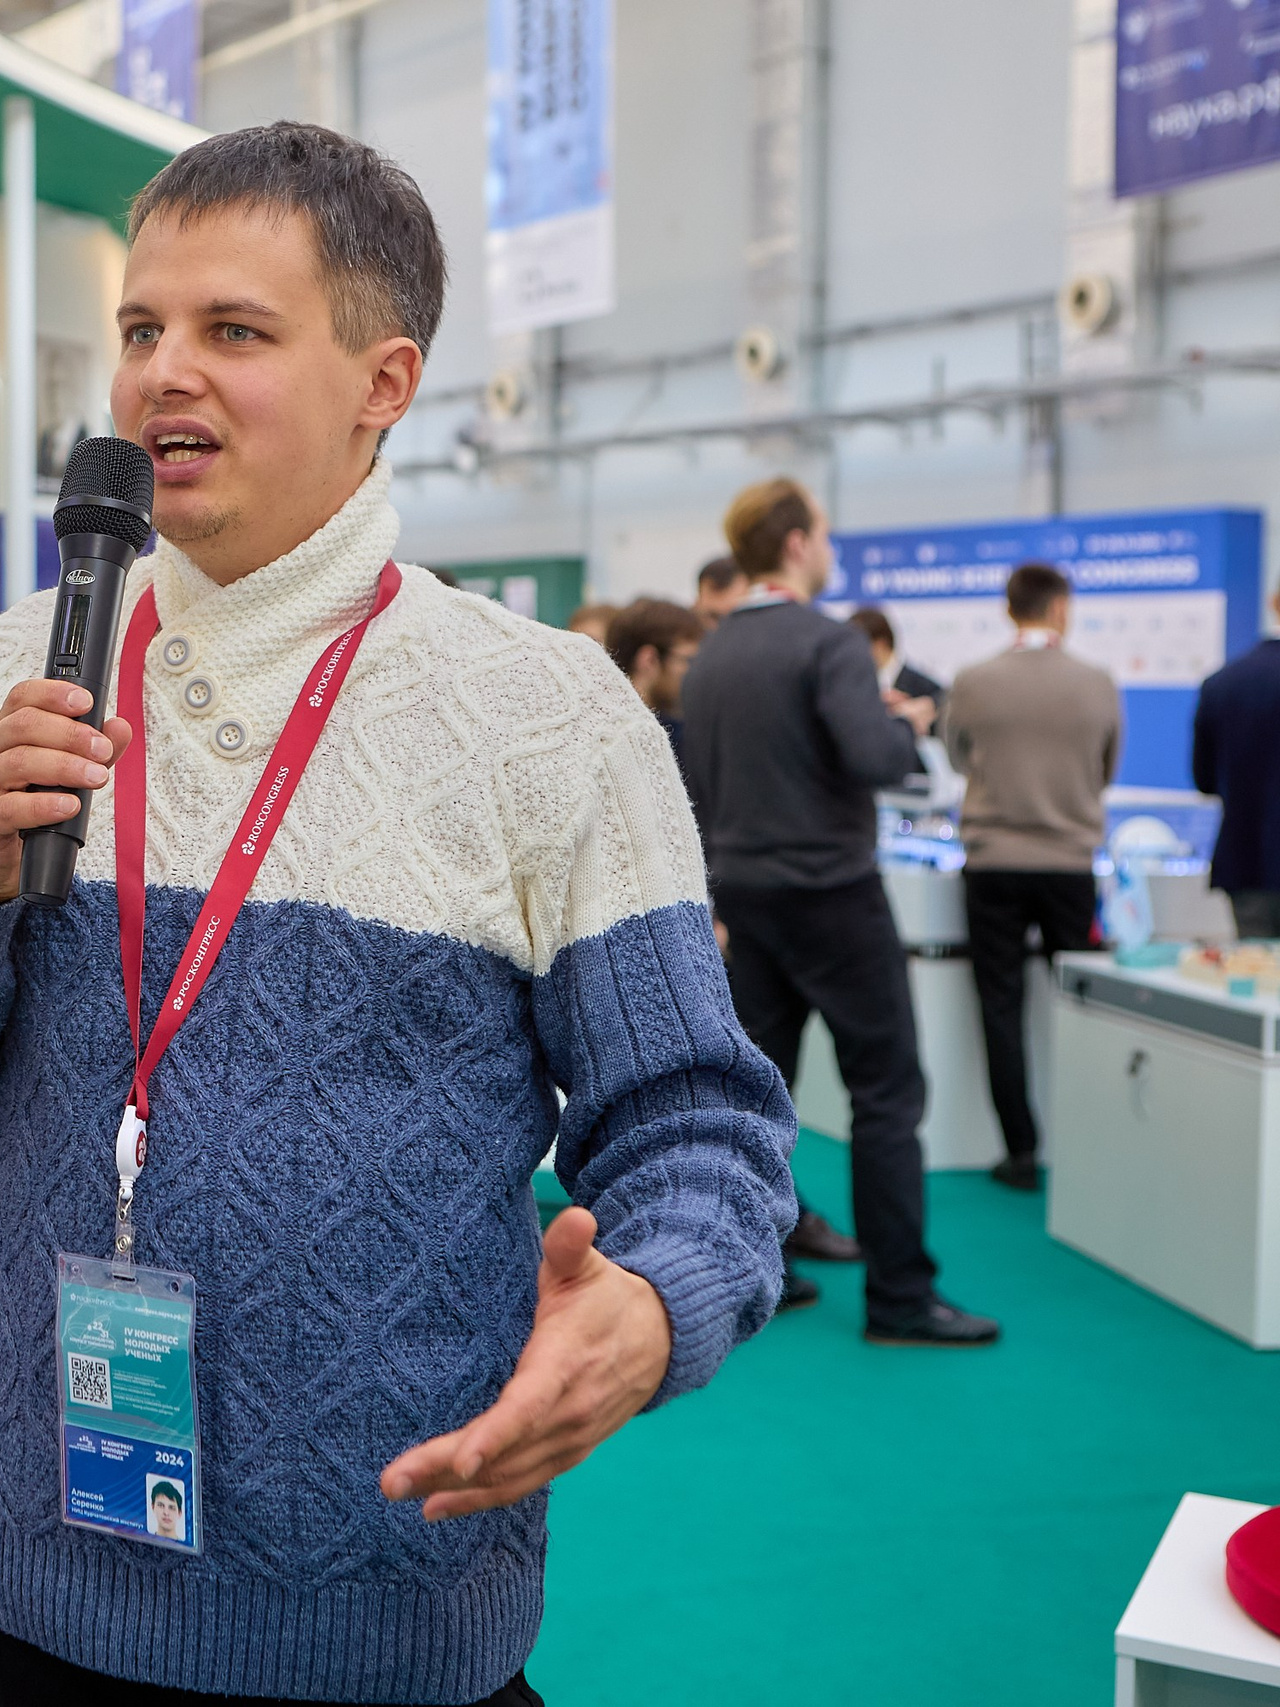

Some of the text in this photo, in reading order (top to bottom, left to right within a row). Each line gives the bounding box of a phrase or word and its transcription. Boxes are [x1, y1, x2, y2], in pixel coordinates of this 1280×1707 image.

[249, 766, 290, 843] ROSCONGRESS
[178, 915, 221, 998] РОСКОНГРЕСС
[124, 1327, 179, 1345] IV КОНГРЕСС
[124, 1338, 171, 1355] МОЛОДЫХ
[125, 1348, 162, 1363] УЧЕНЫХ
[155, 1451, 185, 1468] 2024
[71, 1488, 104, 1502] Алексей
[71, 1498, 105, 1512] Серенко
